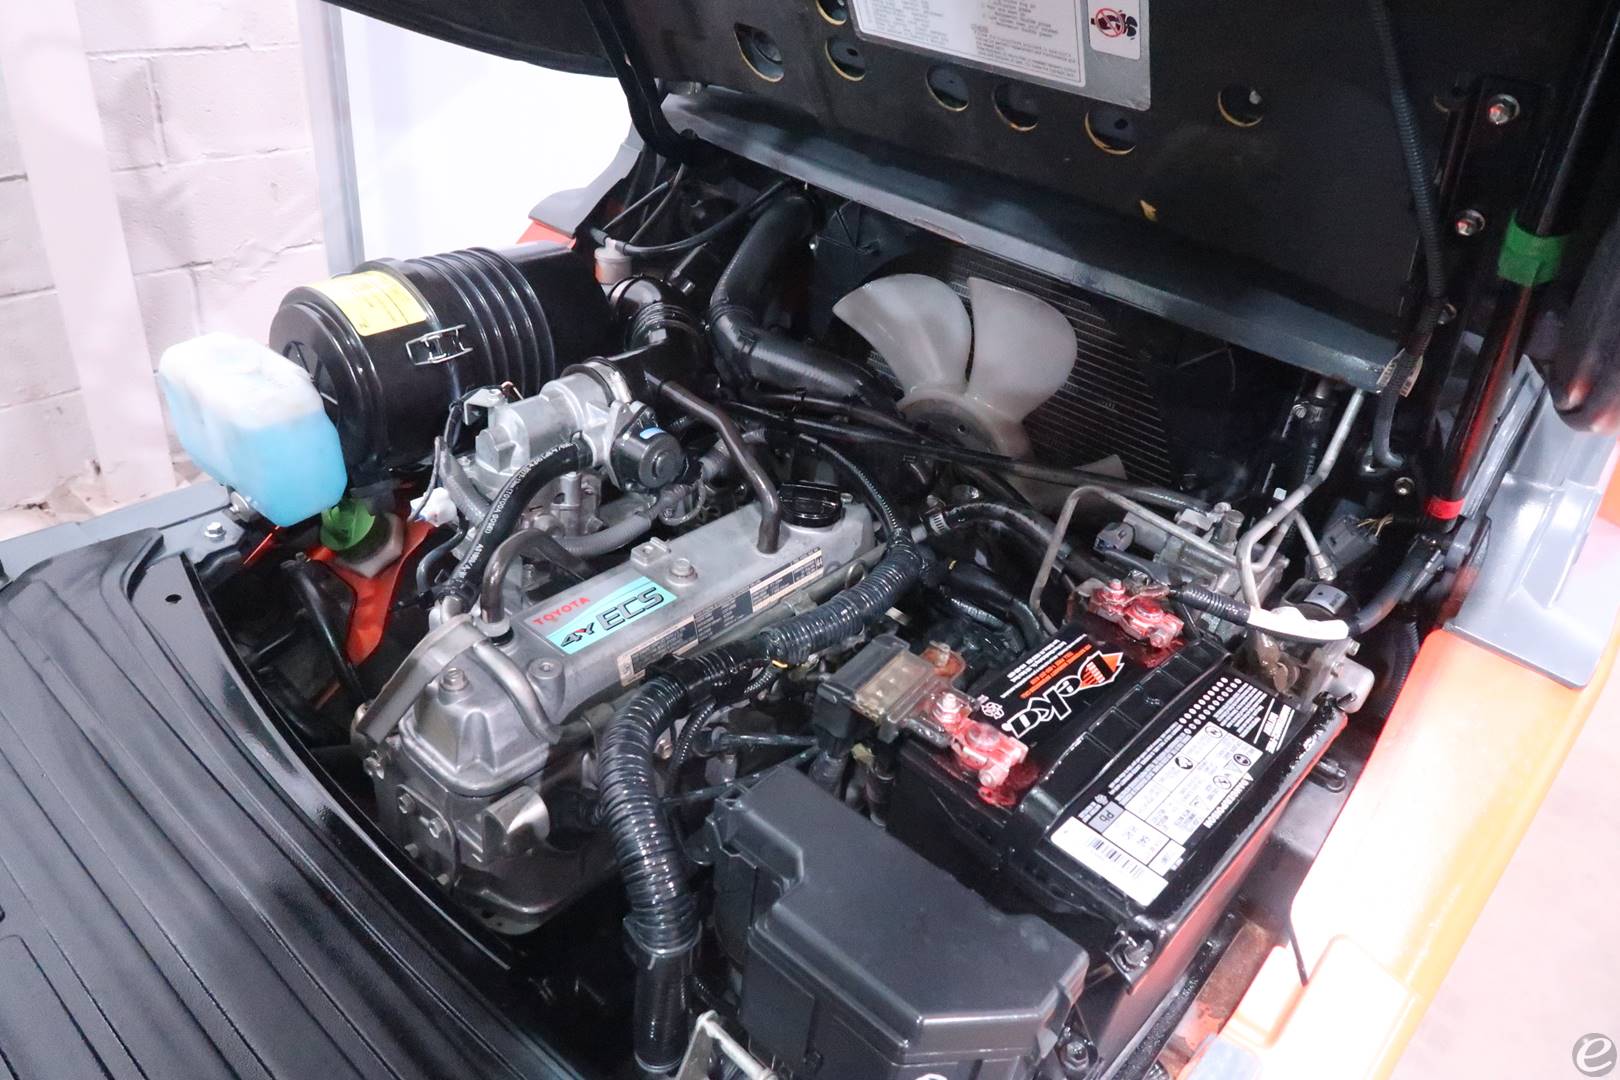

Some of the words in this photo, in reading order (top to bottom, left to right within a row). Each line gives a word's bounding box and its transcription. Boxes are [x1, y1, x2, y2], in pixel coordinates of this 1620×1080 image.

[532, 596, 591, 626] TOYOTA
[561, 621, 595, 647] 4Y
[602, 586, 664, 631] ECS
[1009, 650, 1123, 739] Deka
[1099, 809, 1114, 823] Pb
